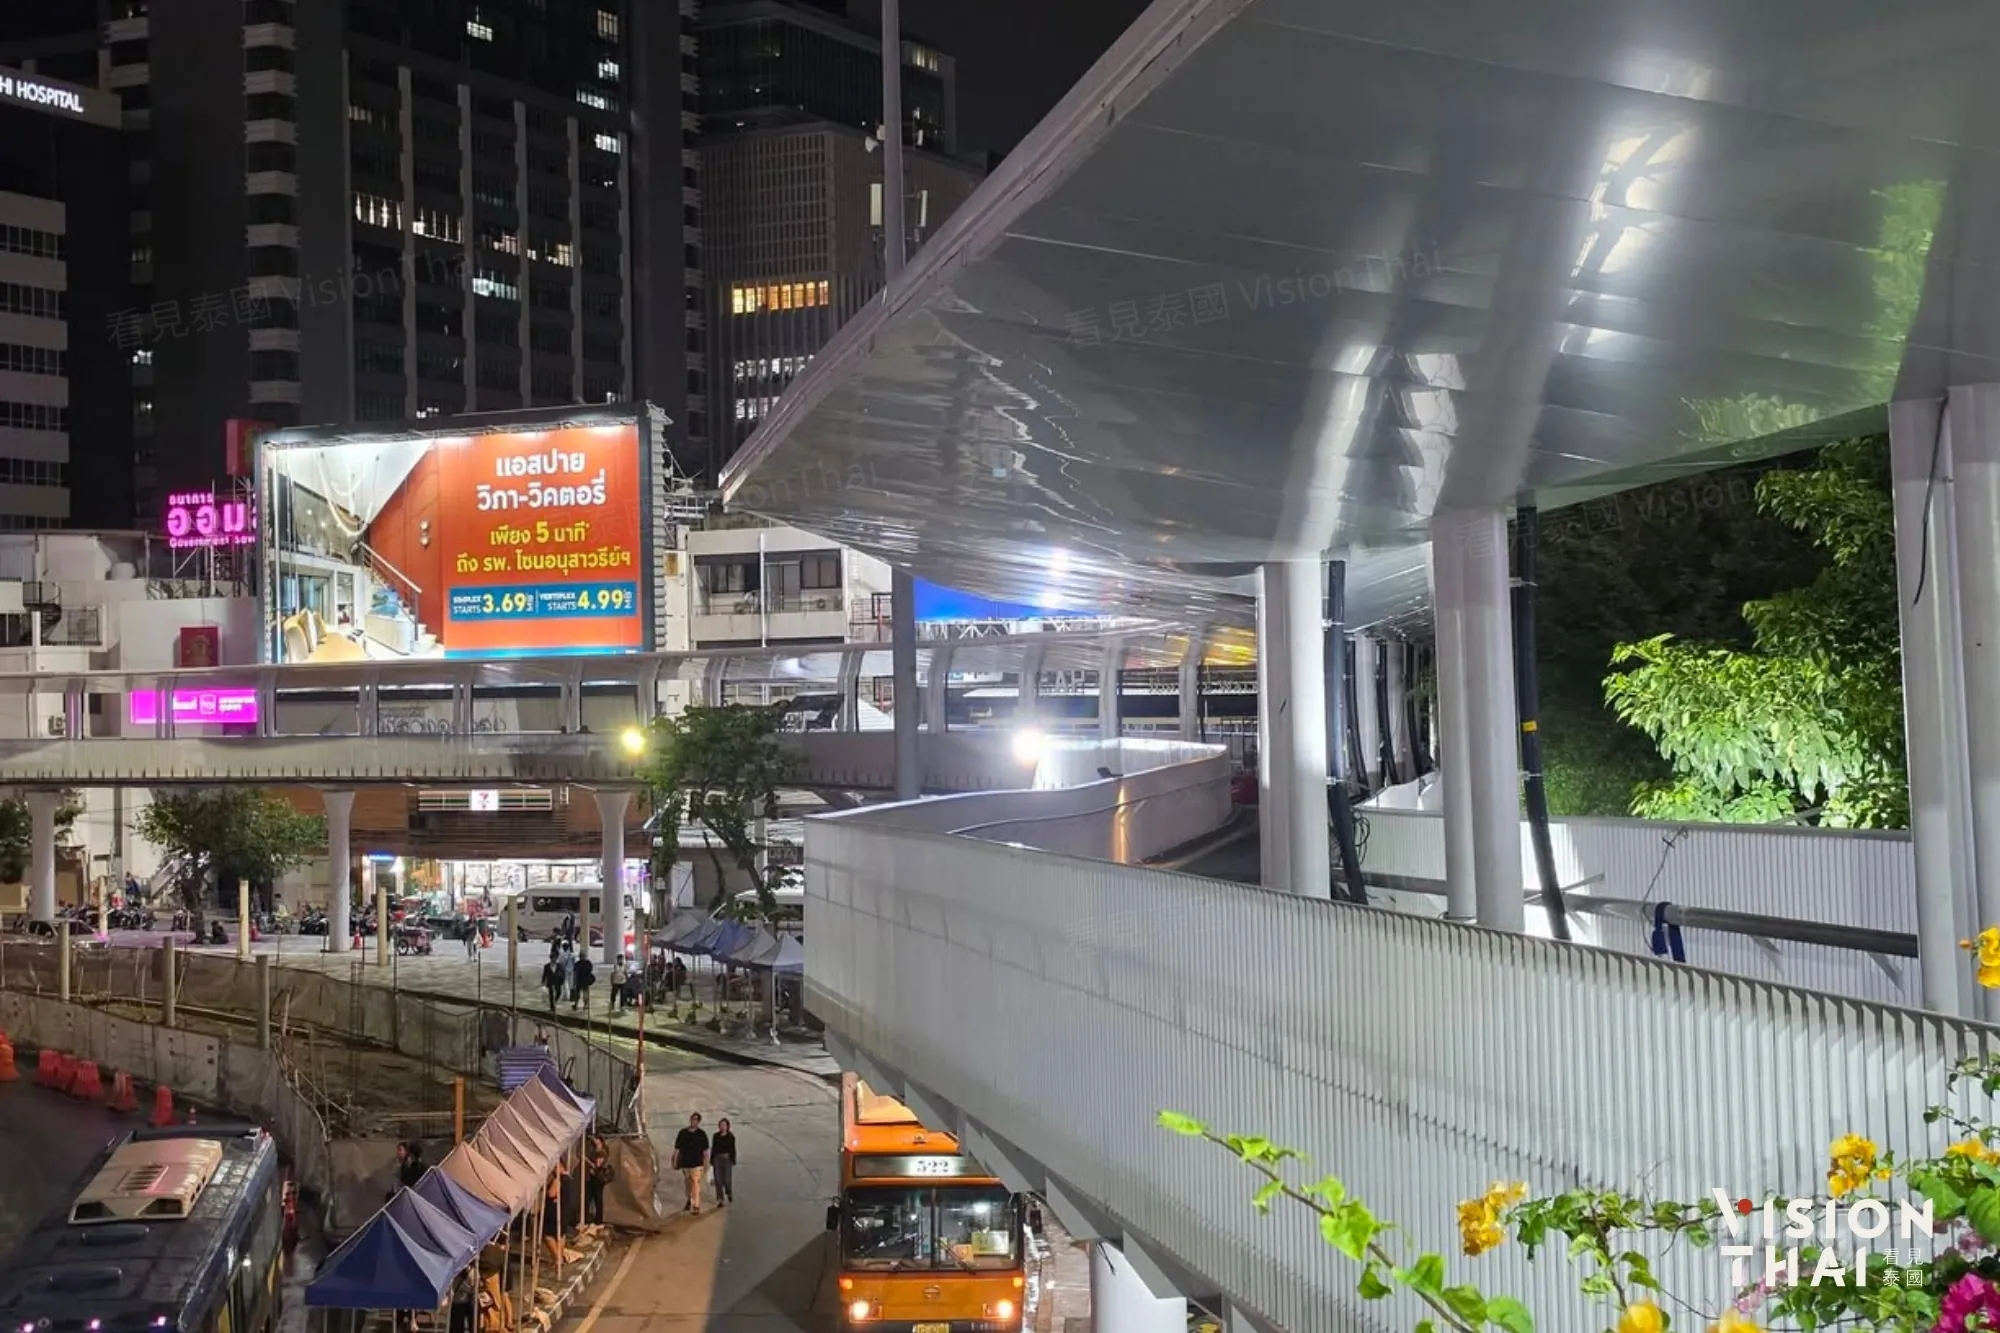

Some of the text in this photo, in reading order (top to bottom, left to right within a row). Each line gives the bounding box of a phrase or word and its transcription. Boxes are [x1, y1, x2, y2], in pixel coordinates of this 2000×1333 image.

[16, 80, 84, 113] HOSPITAL
[495, 448, 585, 477] แอสปาย
[476, 468, 606, 511] วิภา-วิคตอรี่
[167, 503, 257, 537] ออม
[490, 524, 531, 545] เพียง
[536, 521, 549, 543] 5
[456, 551, 478, 573] ถึง
[483, 555, 511, 572] รพ.
[453, 604, 481, 614] STARTS
[482, 593, 526, 613] 3.69
[547, 601, 576, 611] STARTS
[577, 588, 624, 610] 4.99
